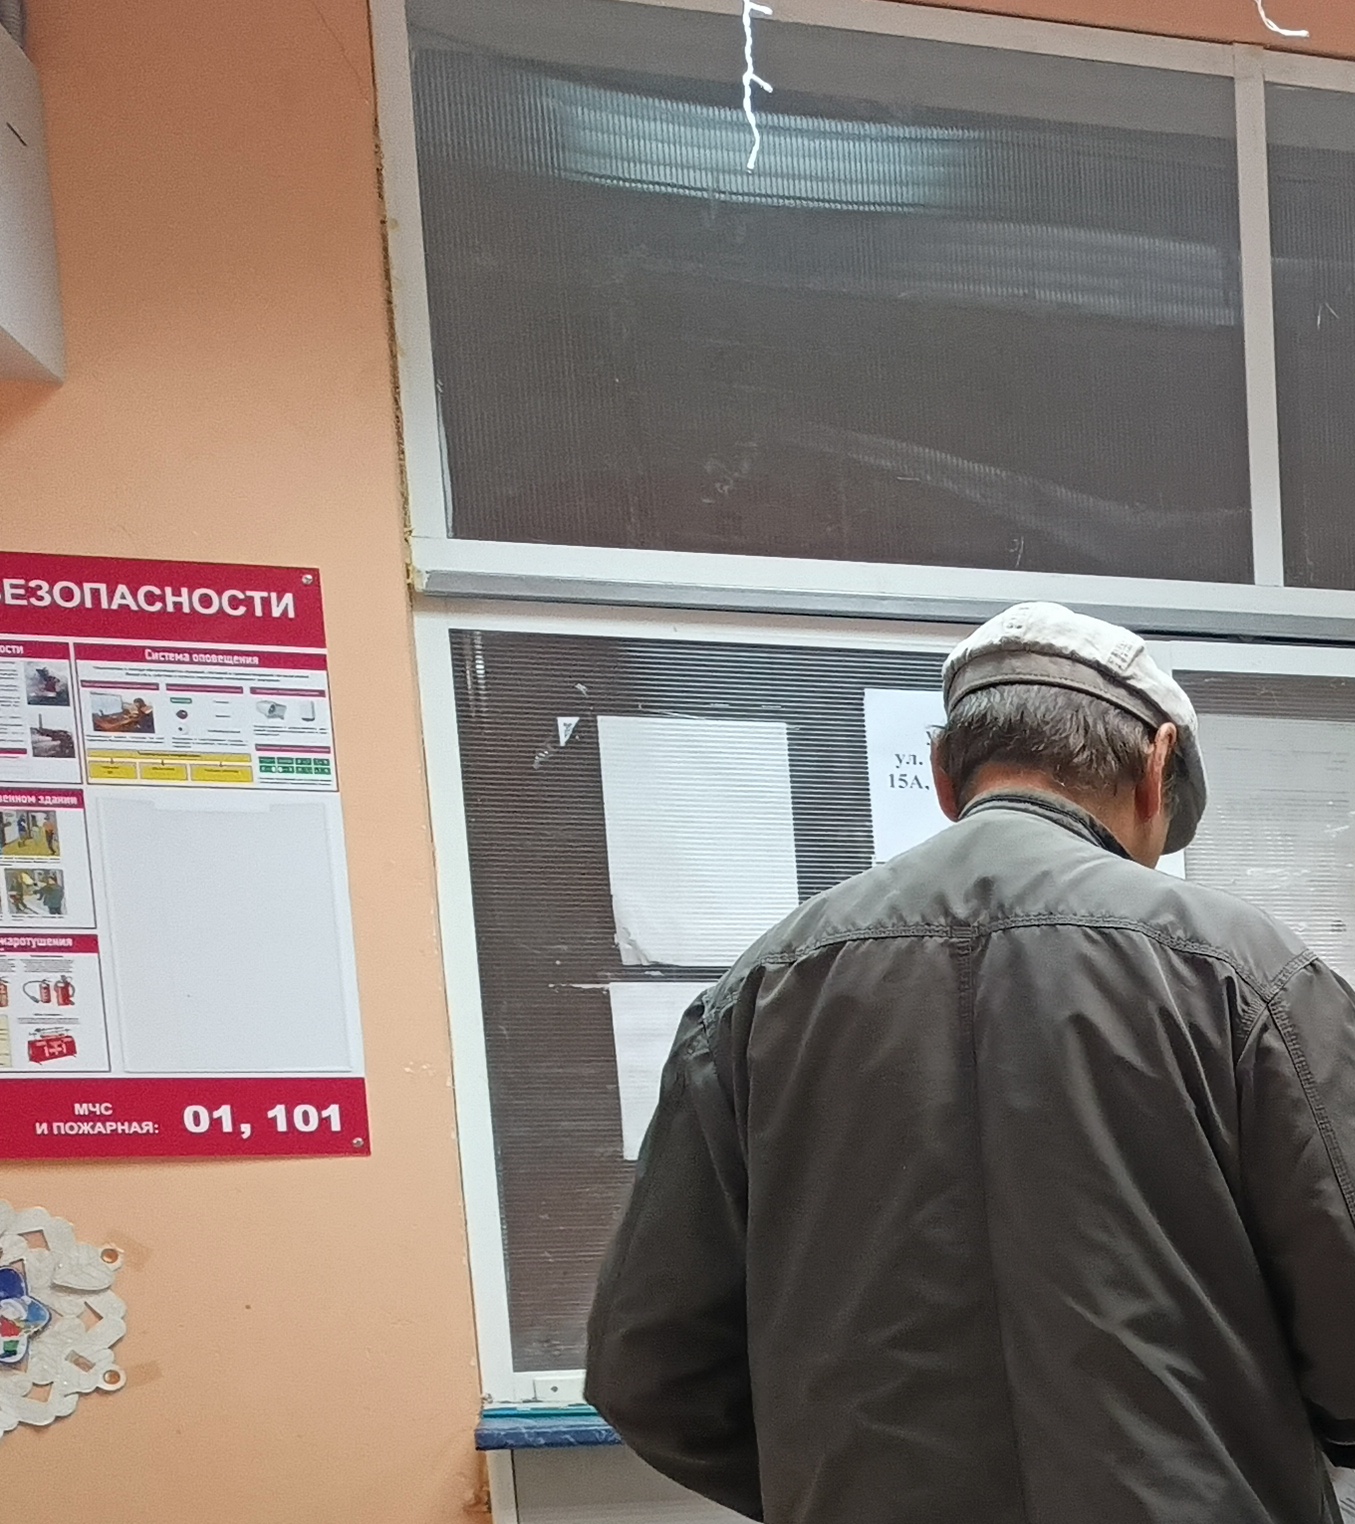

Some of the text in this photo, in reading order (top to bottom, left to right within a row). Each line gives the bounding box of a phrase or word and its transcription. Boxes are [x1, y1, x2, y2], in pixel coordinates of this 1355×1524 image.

[0, 578, 296, 619] ЕЗОПАСНОСТИ
[145, 648, 259, 665] Система оповещения
[894, 753, 923, 769] ул.
[74, 1103, 113, 1115] МЧС
[35, 1121, 159, 1135] И ПОЖАРНАЯ:
[183, 1103, 342, 1139] 01, 101
